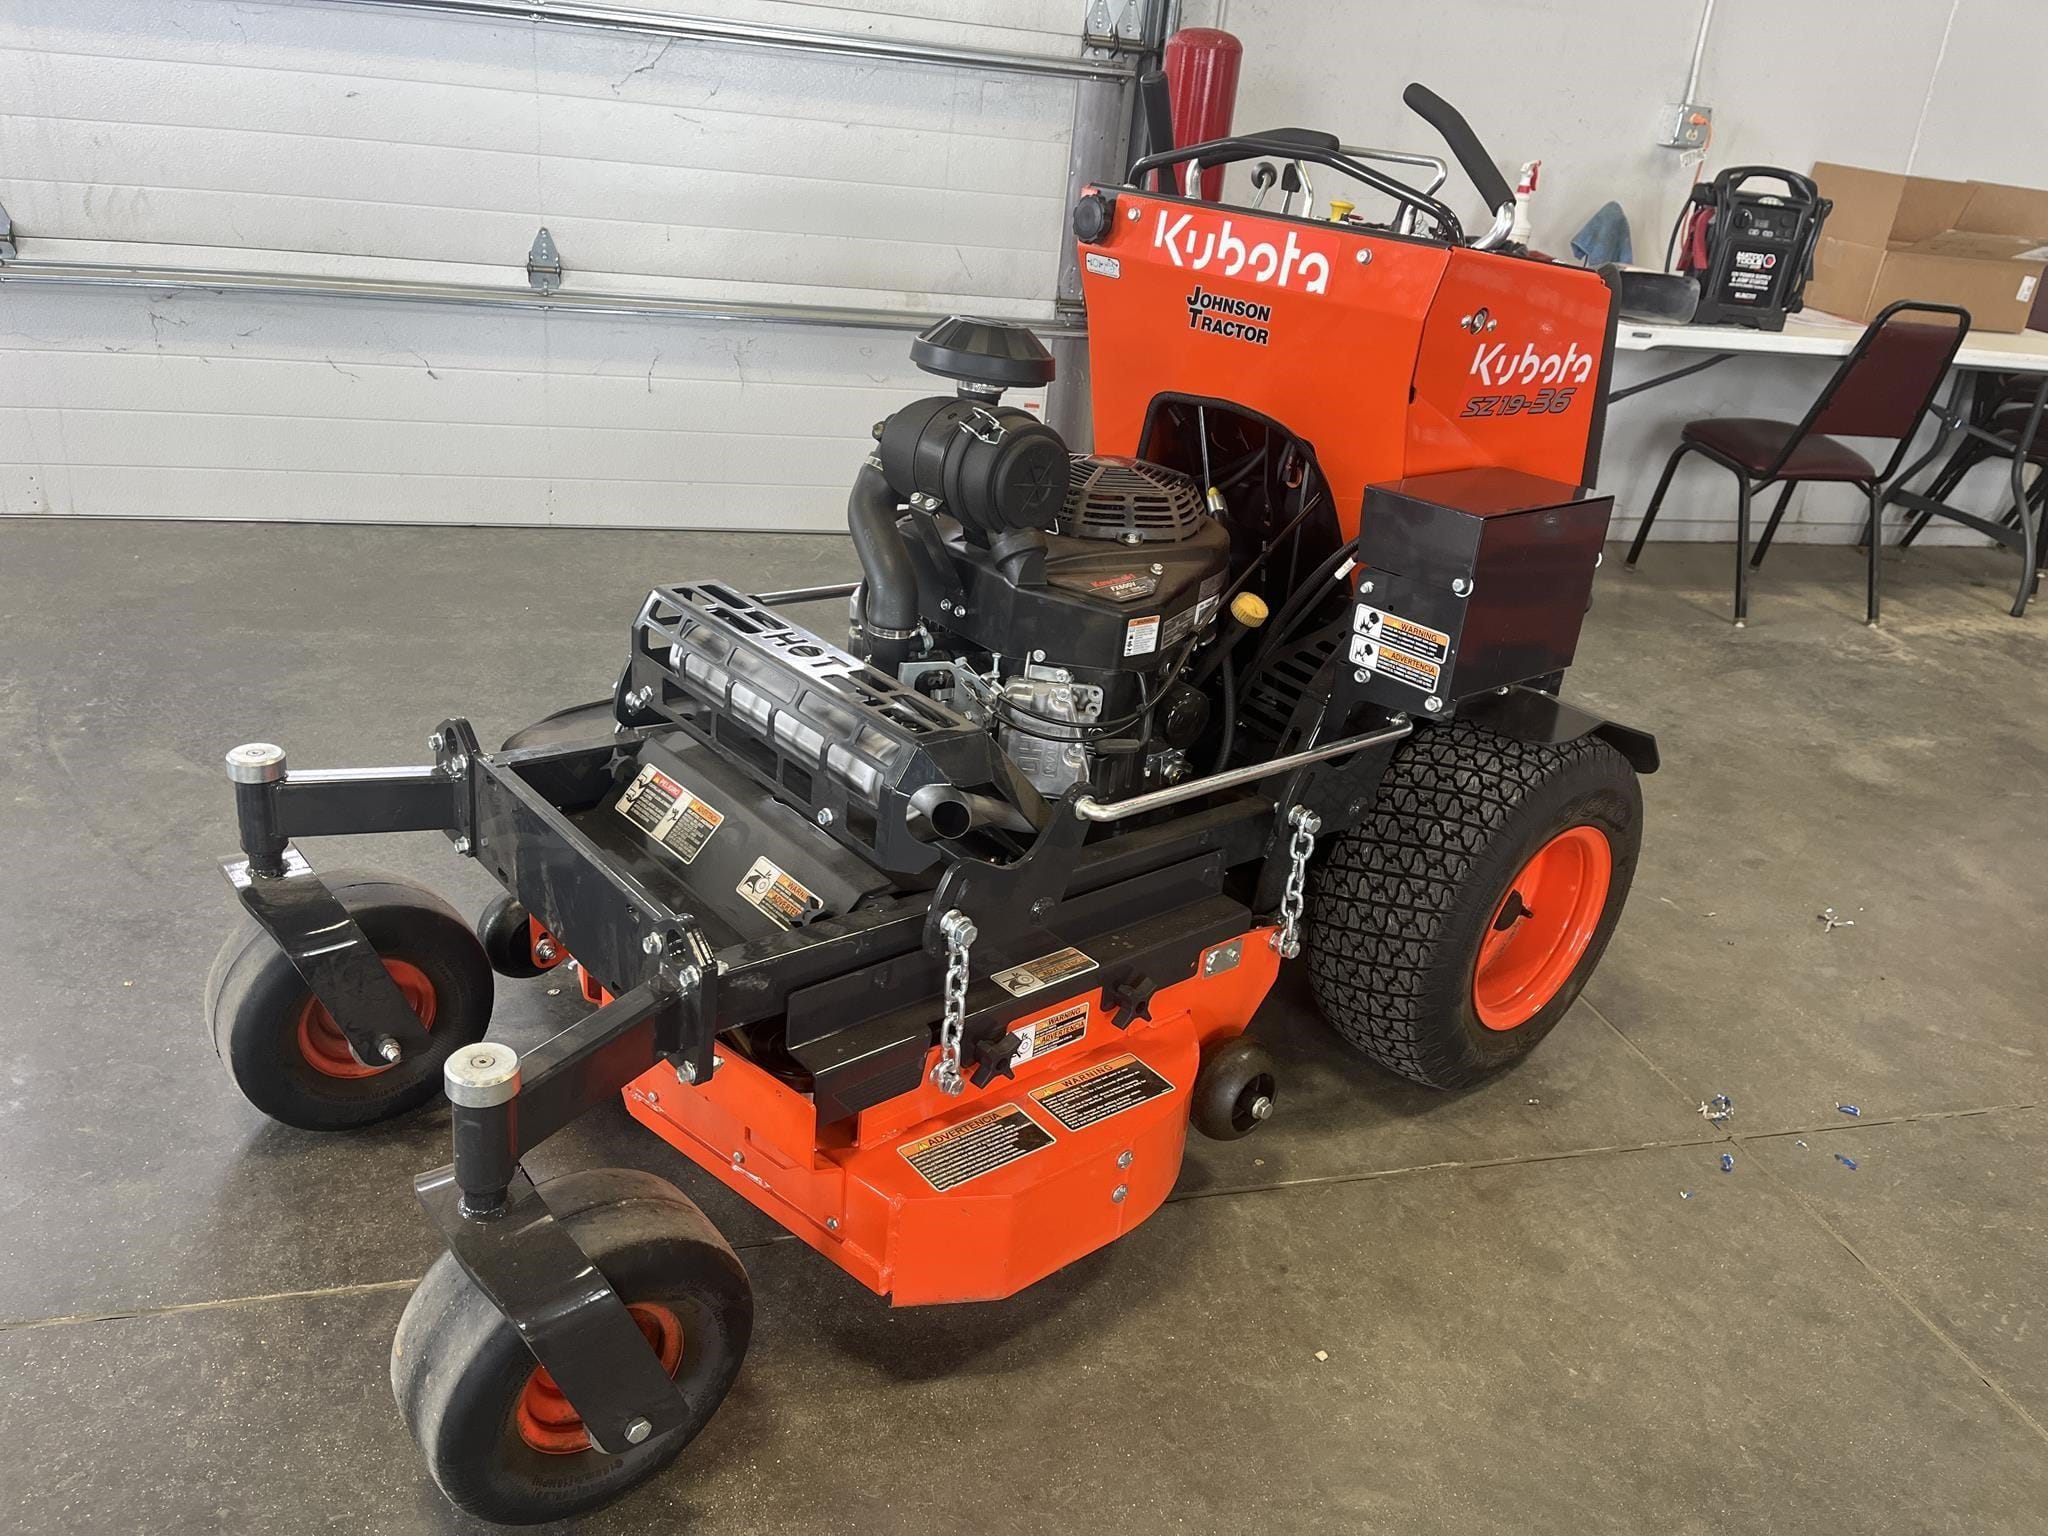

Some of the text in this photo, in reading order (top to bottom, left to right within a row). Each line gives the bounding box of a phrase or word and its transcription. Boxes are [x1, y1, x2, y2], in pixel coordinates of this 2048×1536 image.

[1153, 210, 1330, 295] Kubota
[1186, 286, 1271, 322] JOHNSON
[1188, 307, 1270, 345] TRACTOR
[1469, 342, 1593, 386] Kubota
[1400, 623, 1438, 642] WARNING
[762, 632, 851, 668] HOT
[1390, 652, 1436, 674] ADVERTENCIA
[771, 892, 802, 917] ADVERTEN
[1047, 1007, 1081, 1026] WARNING
[1040, 1021, 1085, 1044] ADVERTENCIA
[1062, 1065, 1114, 1088] WARNING
[927, 1112, 1002, 1147] ADVERTENCIA
